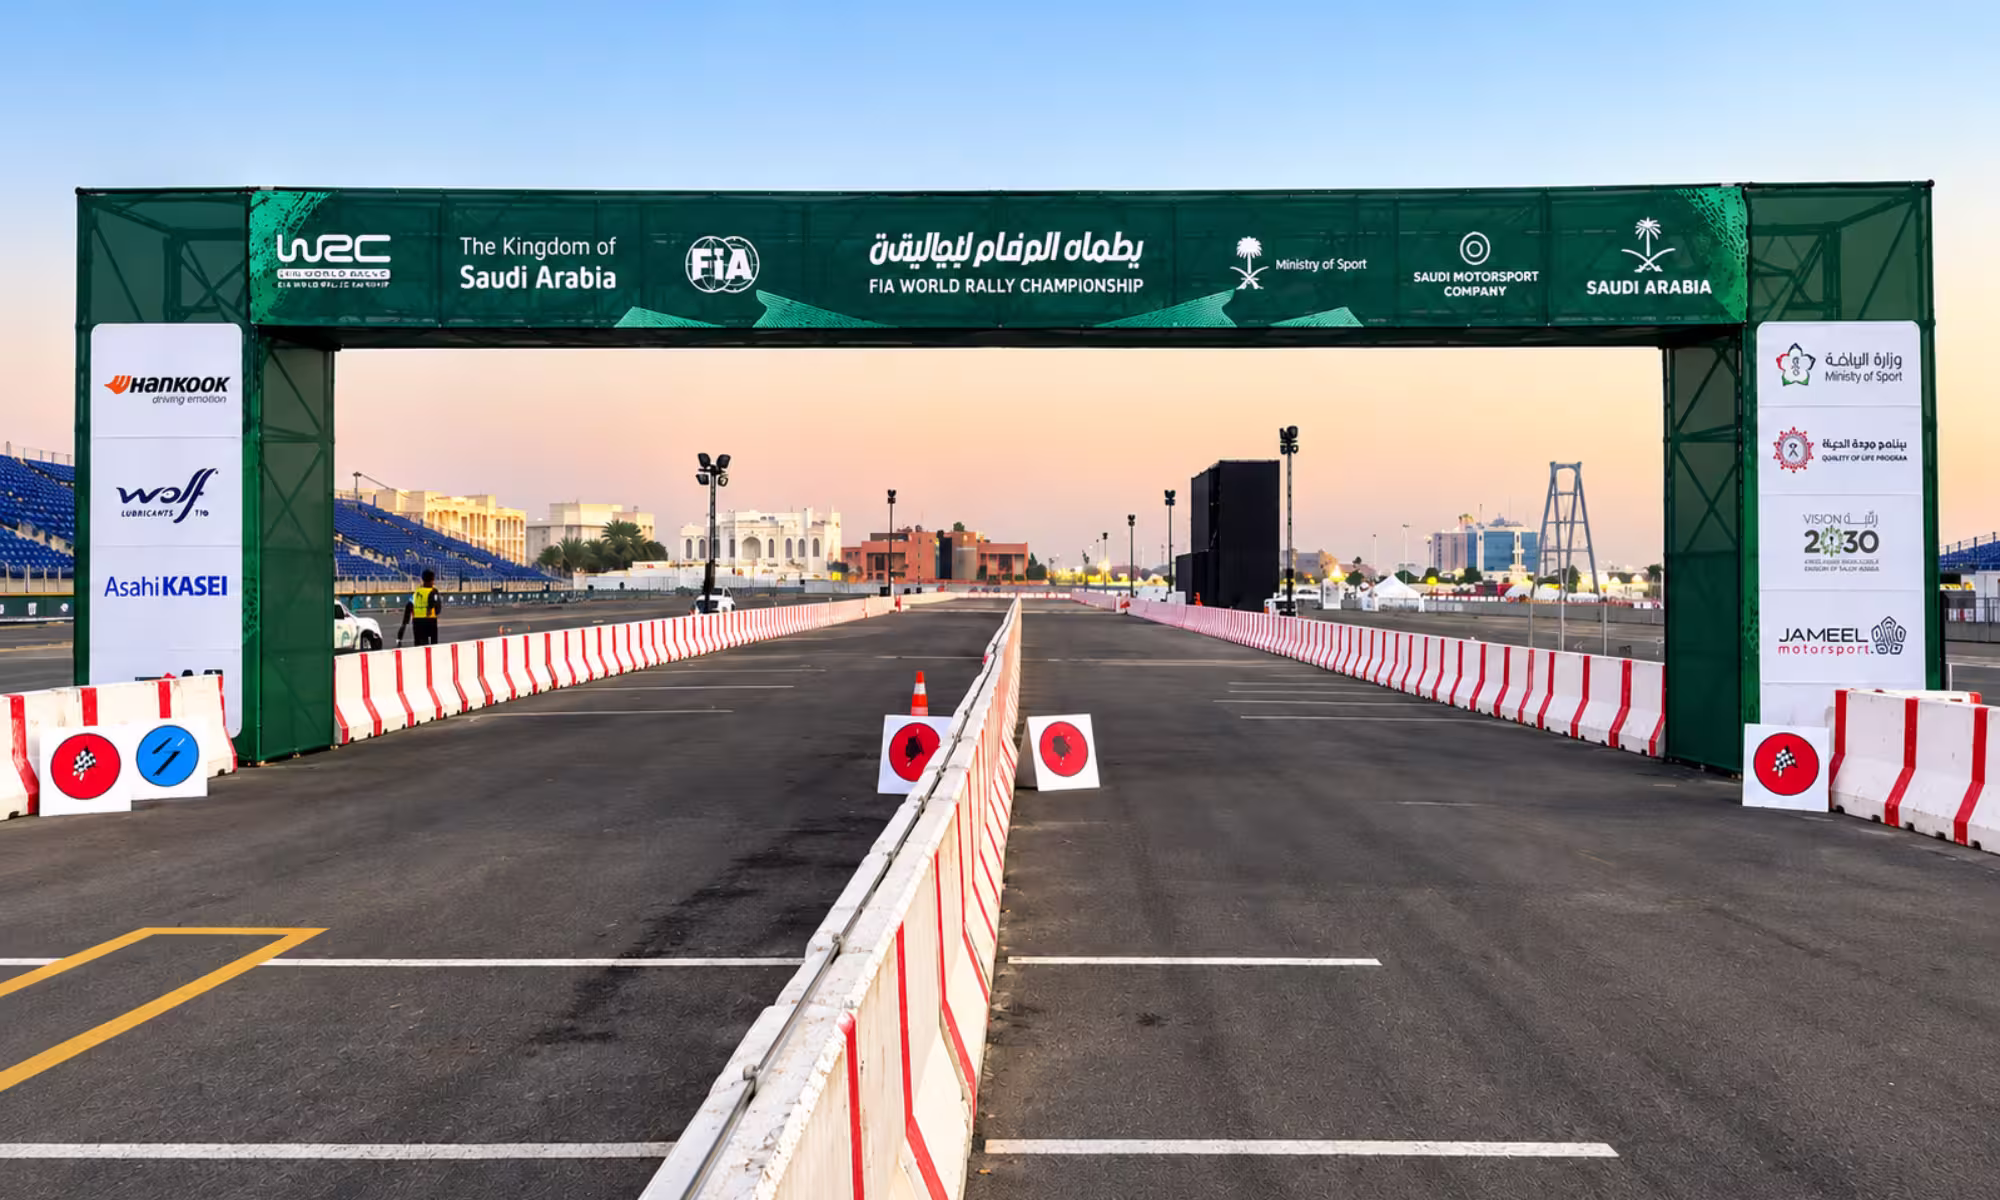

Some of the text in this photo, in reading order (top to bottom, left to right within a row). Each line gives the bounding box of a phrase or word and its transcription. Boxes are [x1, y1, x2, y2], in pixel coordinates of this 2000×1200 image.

[277, 234, 391, 263] WRC
[459, 236, 617, 261] The Kingdom of
[1275, 258, 1368, 273] Ministry of Sport
[460, 264, 617, 289] Saudi Arabia
[1413, 271, 1539, 282] SAUDI MOTORSPORT
[869, 278, 1144, 293] FIA WORLD RALLY CHAMPIONSHIP
[1444, 286, 1507, 297] COMPANY
[1586, 279, 1712, 295] SAUDI ARABIA
[1825, 370, 1903, 384] Ministry of Sport
[152, 395, 227, 406] driving emotion
[1803, 513, 1842, 525] VISION
[1779, 628, 1868, 643] JAMEEL
